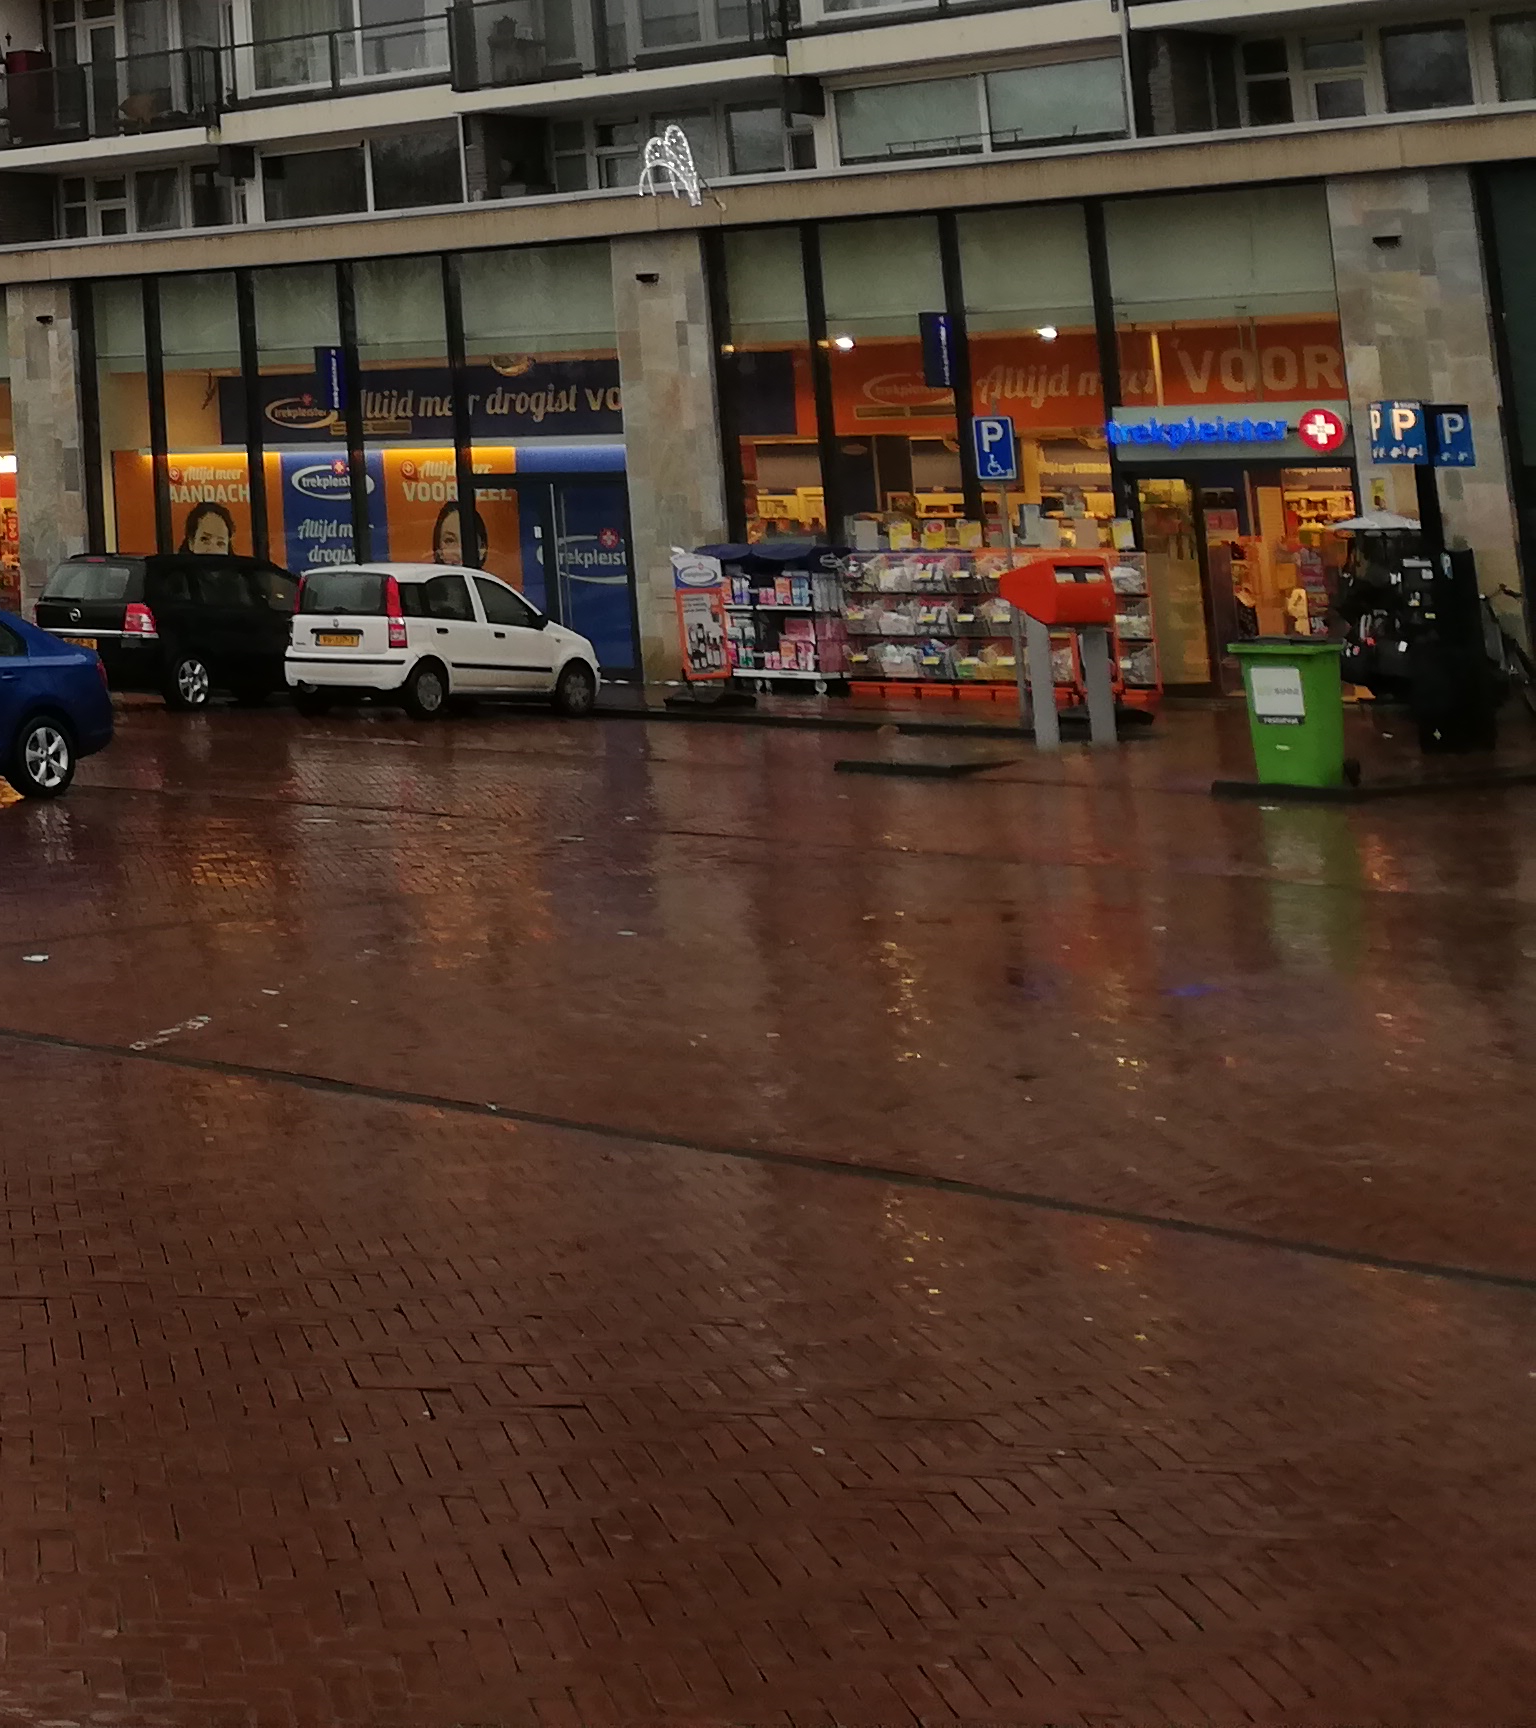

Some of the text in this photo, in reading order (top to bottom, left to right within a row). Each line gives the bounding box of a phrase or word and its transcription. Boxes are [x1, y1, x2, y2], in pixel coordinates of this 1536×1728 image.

[360, 388, 414, 423] ltijd
[418, 393, 480, 418] mer
[486, 383, 577, 422] drogist
[981, 421, 1004, 452] P
[1108, 416, 1288, 450] trekpleister
[1392, 408, 1416, 441] P
[1442, 413, 1464, 444] P
[169, 483, 250, 503] AANDACH
[302, 475, 351, 490] trekpleist
[402, 481, 512, 503] VOOREEL
[298, 518, 338, 543] Altijd
[308, 544, 356, 563] drogis
[558, 547, 627, 569] rekpleist
